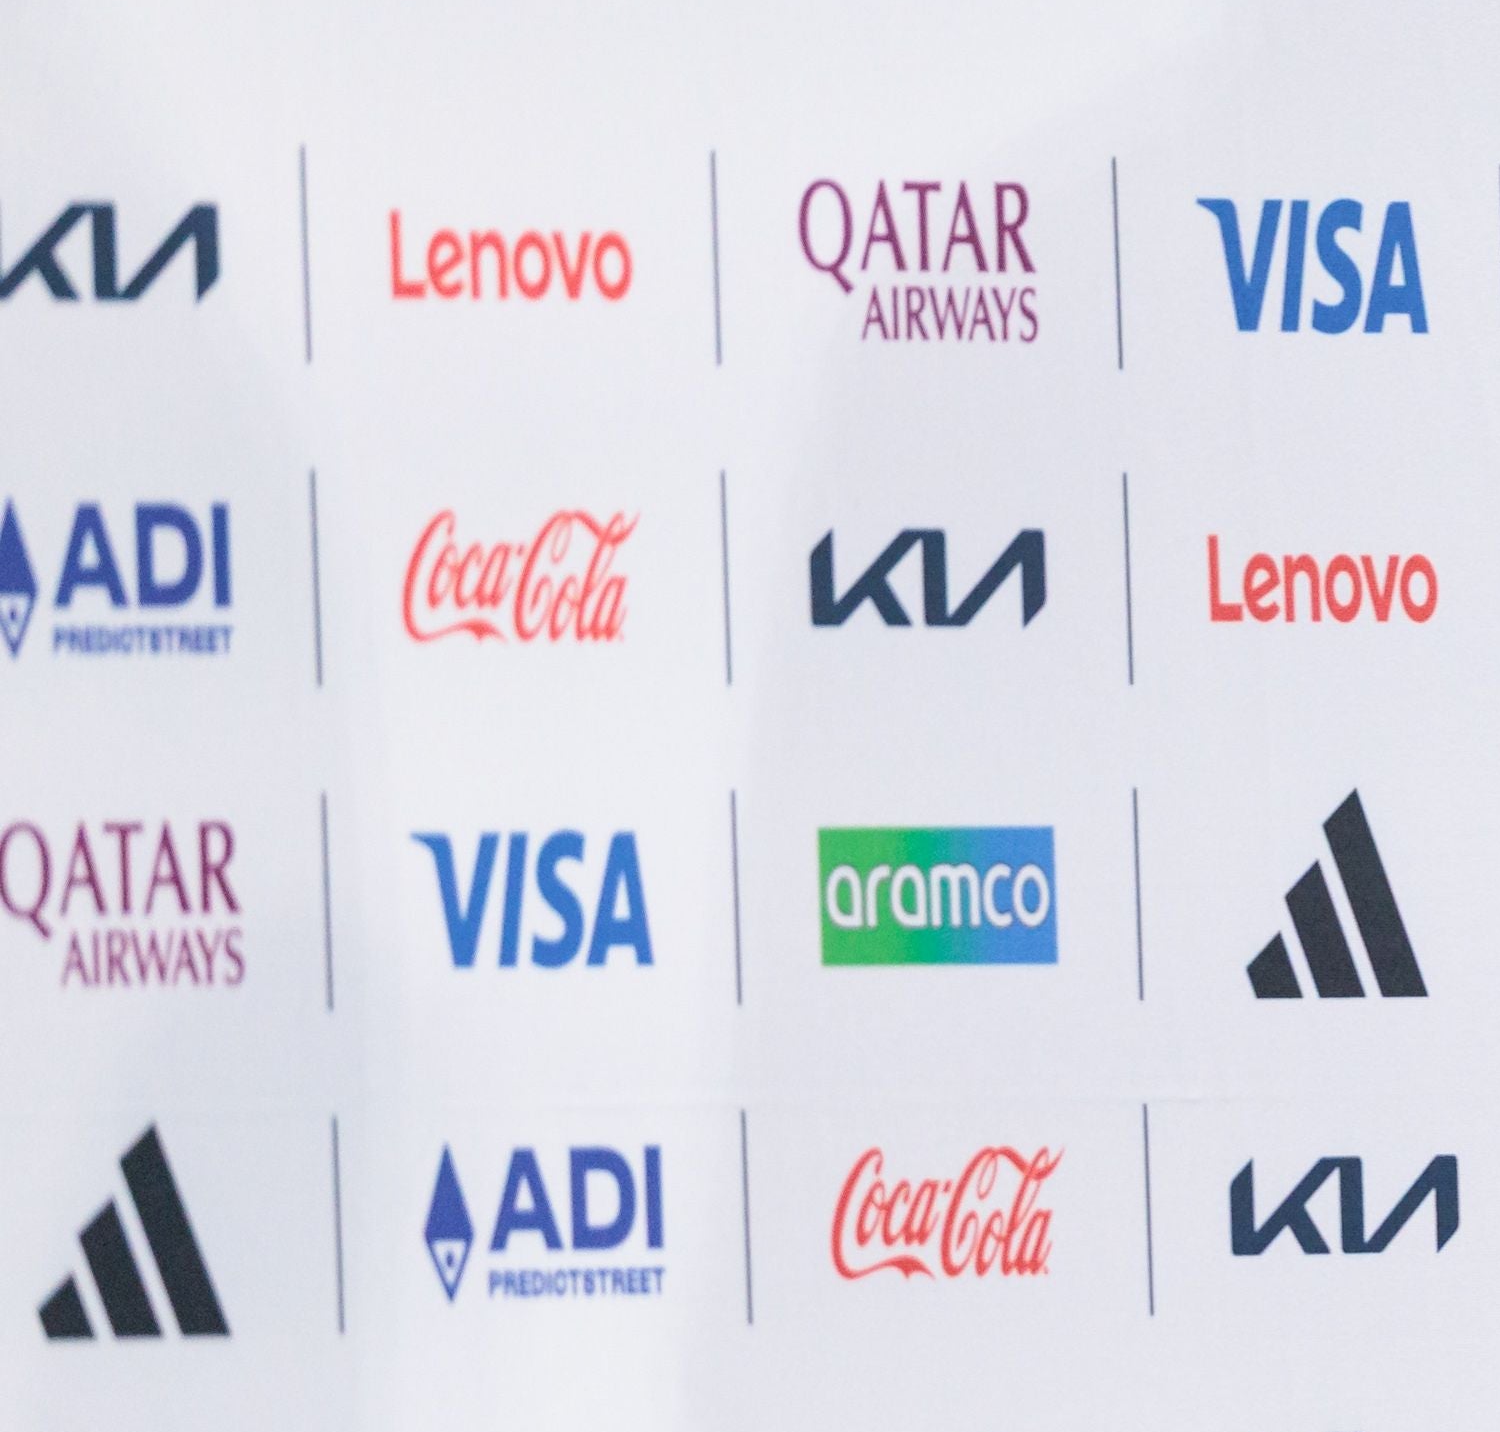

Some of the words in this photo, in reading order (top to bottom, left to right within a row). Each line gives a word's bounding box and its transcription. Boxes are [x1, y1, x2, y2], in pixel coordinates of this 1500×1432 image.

[390, 210, 632, 301] Lenovo
[799, 180, 1035, 296] QATAR
[1196, 198, 1428, 335] VISA
[862, 286, 1038, 343] AIRWAYS
[54, 503, 231, 609] ADI
[402, 510, 636, 642] Coca-Cola
[809, 529, 1047, 627] KIA
[1207, 535, 1438, 623] Lenovo
[0, 822, 239, 940] QATAR
[412, 830, 654, 969] VISA
[826, 862, 1050, 928] aramco
[63, 929, 245, 986] AIRWAYS
[489, 1145, 664, 1252] ADI
[831, 1146, 1061, 1280] Coca-Cola
[1229, 1155, 1460, 1256] KIA
